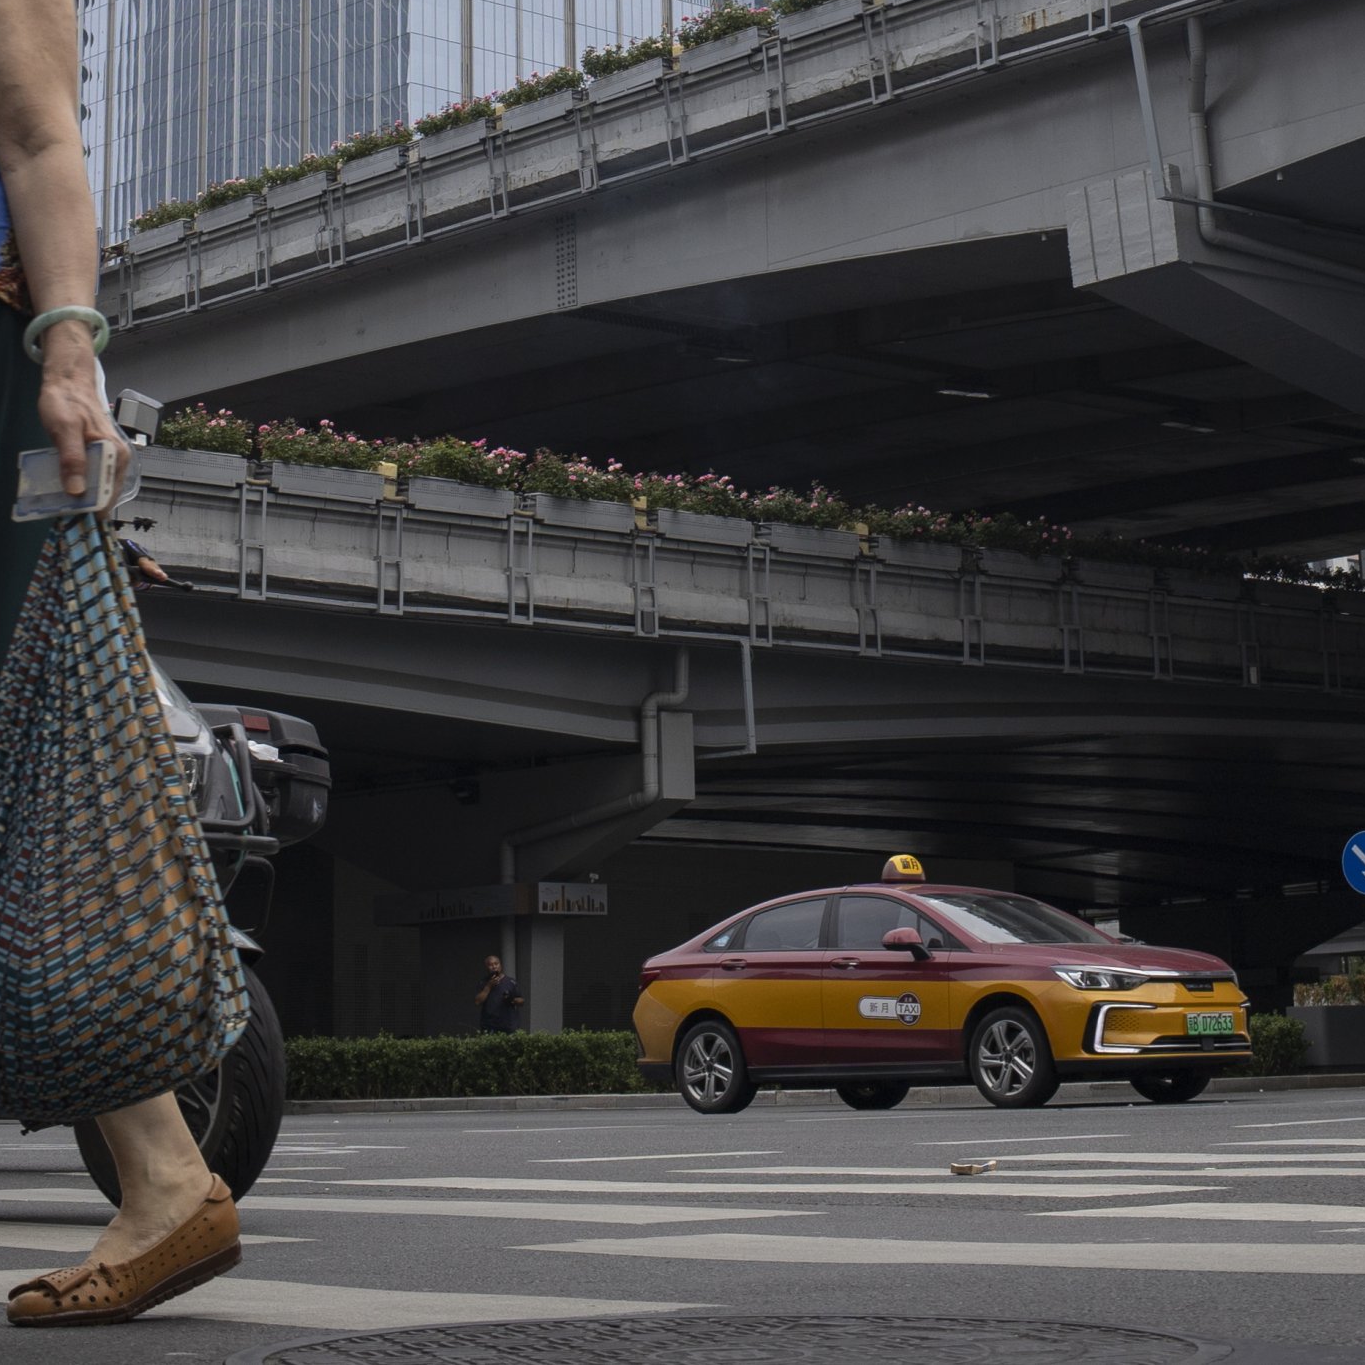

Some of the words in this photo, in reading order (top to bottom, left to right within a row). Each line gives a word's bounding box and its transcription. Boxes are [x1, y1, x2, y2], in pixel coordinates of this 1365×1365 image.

[900, 858, 919, 870] 新月
[869, 1002, 889, 1013] 新月
[898, 1004, 919, 1013] TAXI
